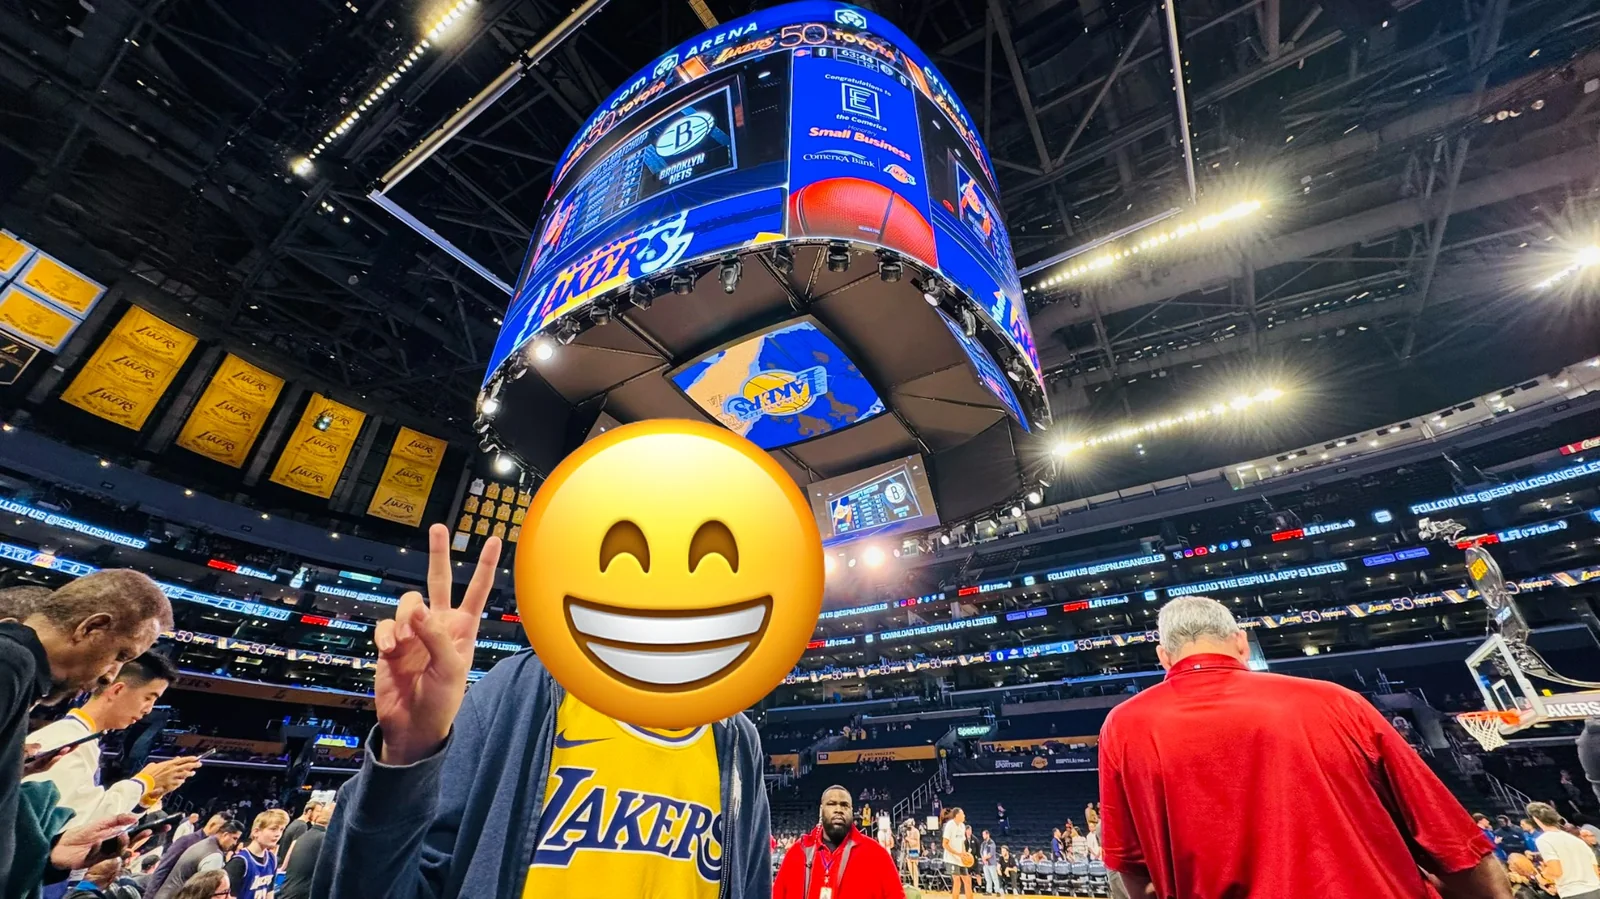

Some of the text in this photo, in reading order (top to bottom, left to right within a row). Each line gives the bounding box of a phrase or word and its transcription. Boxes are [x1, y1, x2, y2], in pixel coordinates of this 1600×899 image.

[685, 22, 758, 58] ARENA
[712, 24, 896, 66] LAKERS 50 TOYOTA
[818, 47, 874, 64] 0 63:44
[824, 73, 884, 93] Congratulations
[618, 80, 666, 117] TOYOTA
[836, 113, 888, 132] the Comerica
[675, 120, 693, 150] B
[809, 126, 912, 161] Small Business
[659, 153, 706, 180] BROOKLYN
[851, 156, 876, 168] Bank
[669, 168, 693, 185] NETS
[135, 326, 177, 350] LAKERS
[113, 355, 156, 379] LAKERS
[232, 371, 268, 392] LAKERS
[88, 387, 135, 412] LAKERS
[215, 400, 252, 422] LAKERS
[196, 431, 235, 452] LAKERS
[304, 435, 338, 453] LAKERS
[407, 440, 436, 455] LAKERS
[290, 466, 324, 484] LAKERS
[394, 468, 424, 483] LAKERS
[382, 497, 415, 514] LAKERS
[1411, 498, 1459, 515] FOLLOW
[1458, 493, 1477, 505] US
[28, 509, 47, 521] US
[44, 513, 148, 550] @ESPNLOSANGELES
[1047, 554, 1166, 581] FOLLOW US @ESPNLOSANGELES
[1167, 561, 1348, 597] DOWNLOAD THE ESPN LA APP & LISTEN
[1518, 579, 1553, 591] TOYOTA
[315, 584, 347, 597] FOLLOW
[346, 590, 358, 599] US
[834, 602, 888, 619] @ESPNLOSANGELES
[1392, 596, 1415, 612] 50
[1413, 595, 1444, 605] TOYOTA
[1301, 609, 1321, 624] 50
[1320, 610, 1347, 619] TOYOTA
[175, 630, 194, 643] 50
[880, 628, 915, 640] DOWNLOAD
[914, 626, 926, 635] THE
[927, 624, 944, 634] ESPN
[943, 622, 953, 631] LA
[952, 620, 966, 629] APP
[972, 616, 998, 626] LISTEN
[1146, 631, 1160, 643] 50
[248, 643, 266, 655] 50
[498, 643, 521, 652] LISTEN
[996, 651, 1004, 661] 0
[1023, 646, 1040, 655] 63:44
[1061, 643, 1070, 652] 0
[1078, 639, 1093, 651] 50
[317, 653, 332, 665] 50
[929, 659, 942, 669] 50
[831, 670, 843, 681] 50
[879, 665, 891, 675] 50
[957, 725, 991, 737] Spectrum
[995, 761, 1024, 769] SPORTSNET
[530, 766, 722, 884] LAKERS
